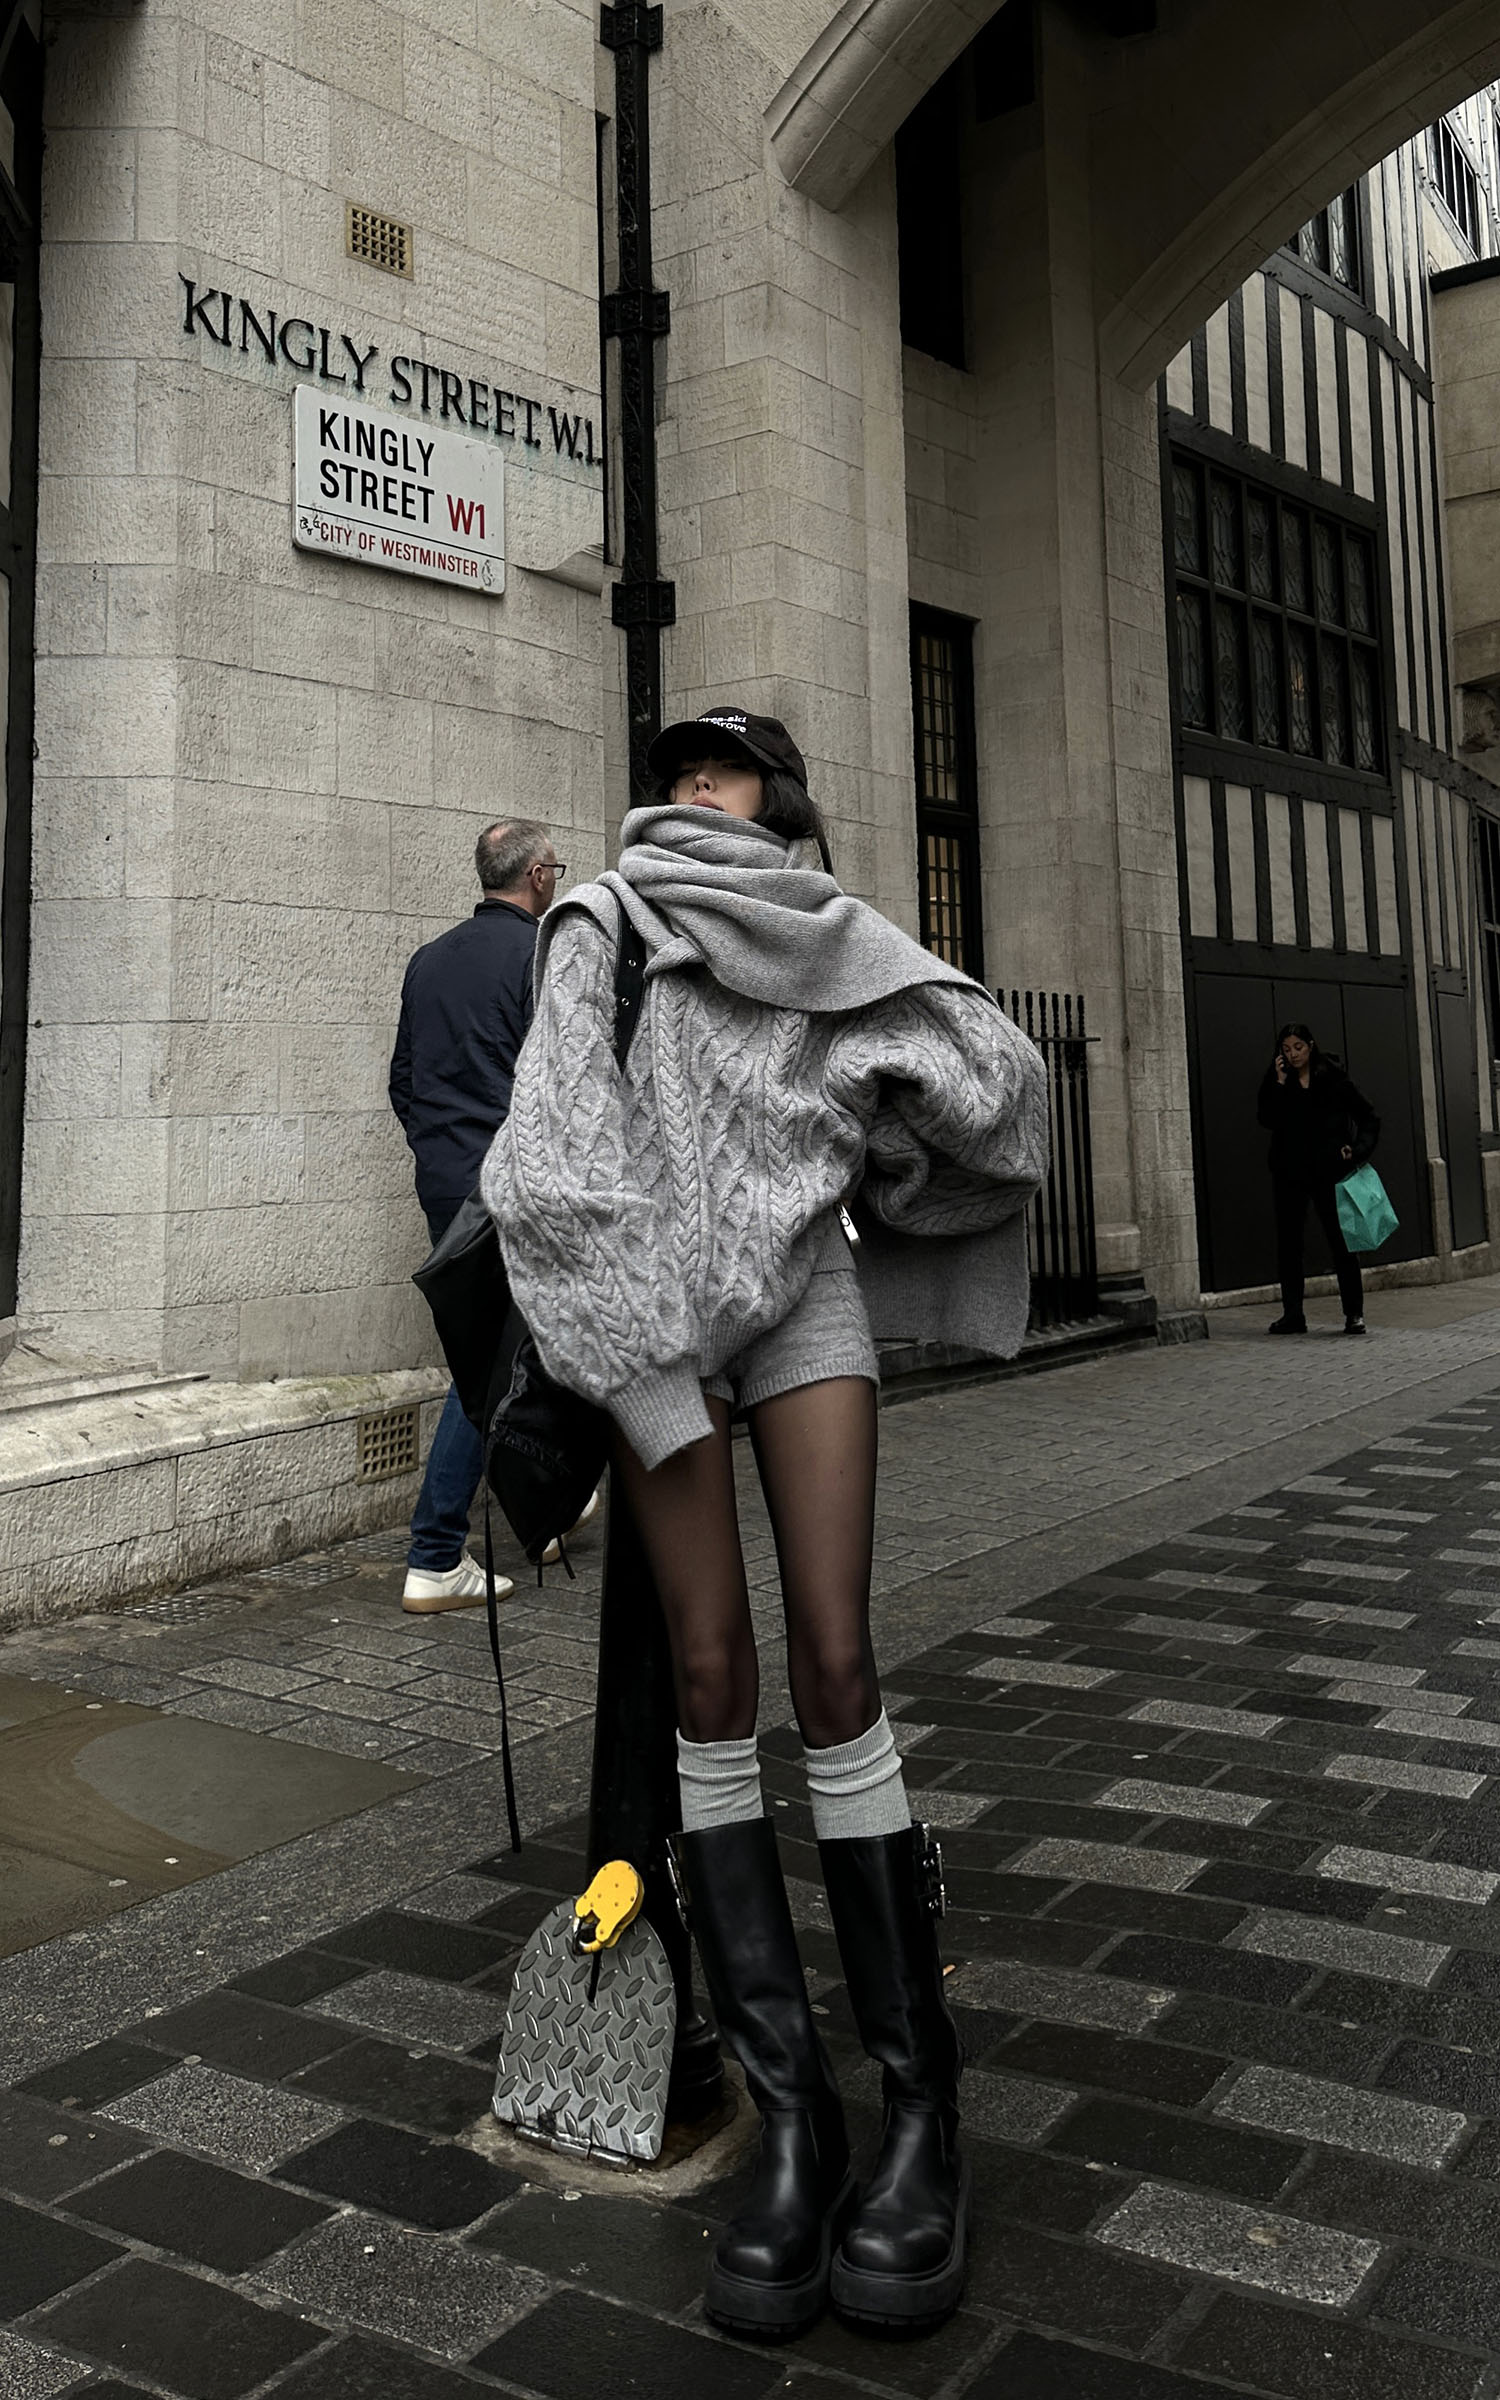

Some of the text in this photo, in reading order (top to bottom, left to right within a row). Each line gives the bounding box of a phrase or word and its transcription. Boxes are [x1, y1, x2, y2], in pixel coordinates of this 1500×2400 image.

[179, 274, 379, 389] KINGLY
[319, 408, 435, 477] KINGLY
[319, 458, 486, 540] STREET W1
[320, 522, 352, 546] CITY
[358, 532, 376, 552] OF
[380, 537, 479, 578] WESTMINSTER
